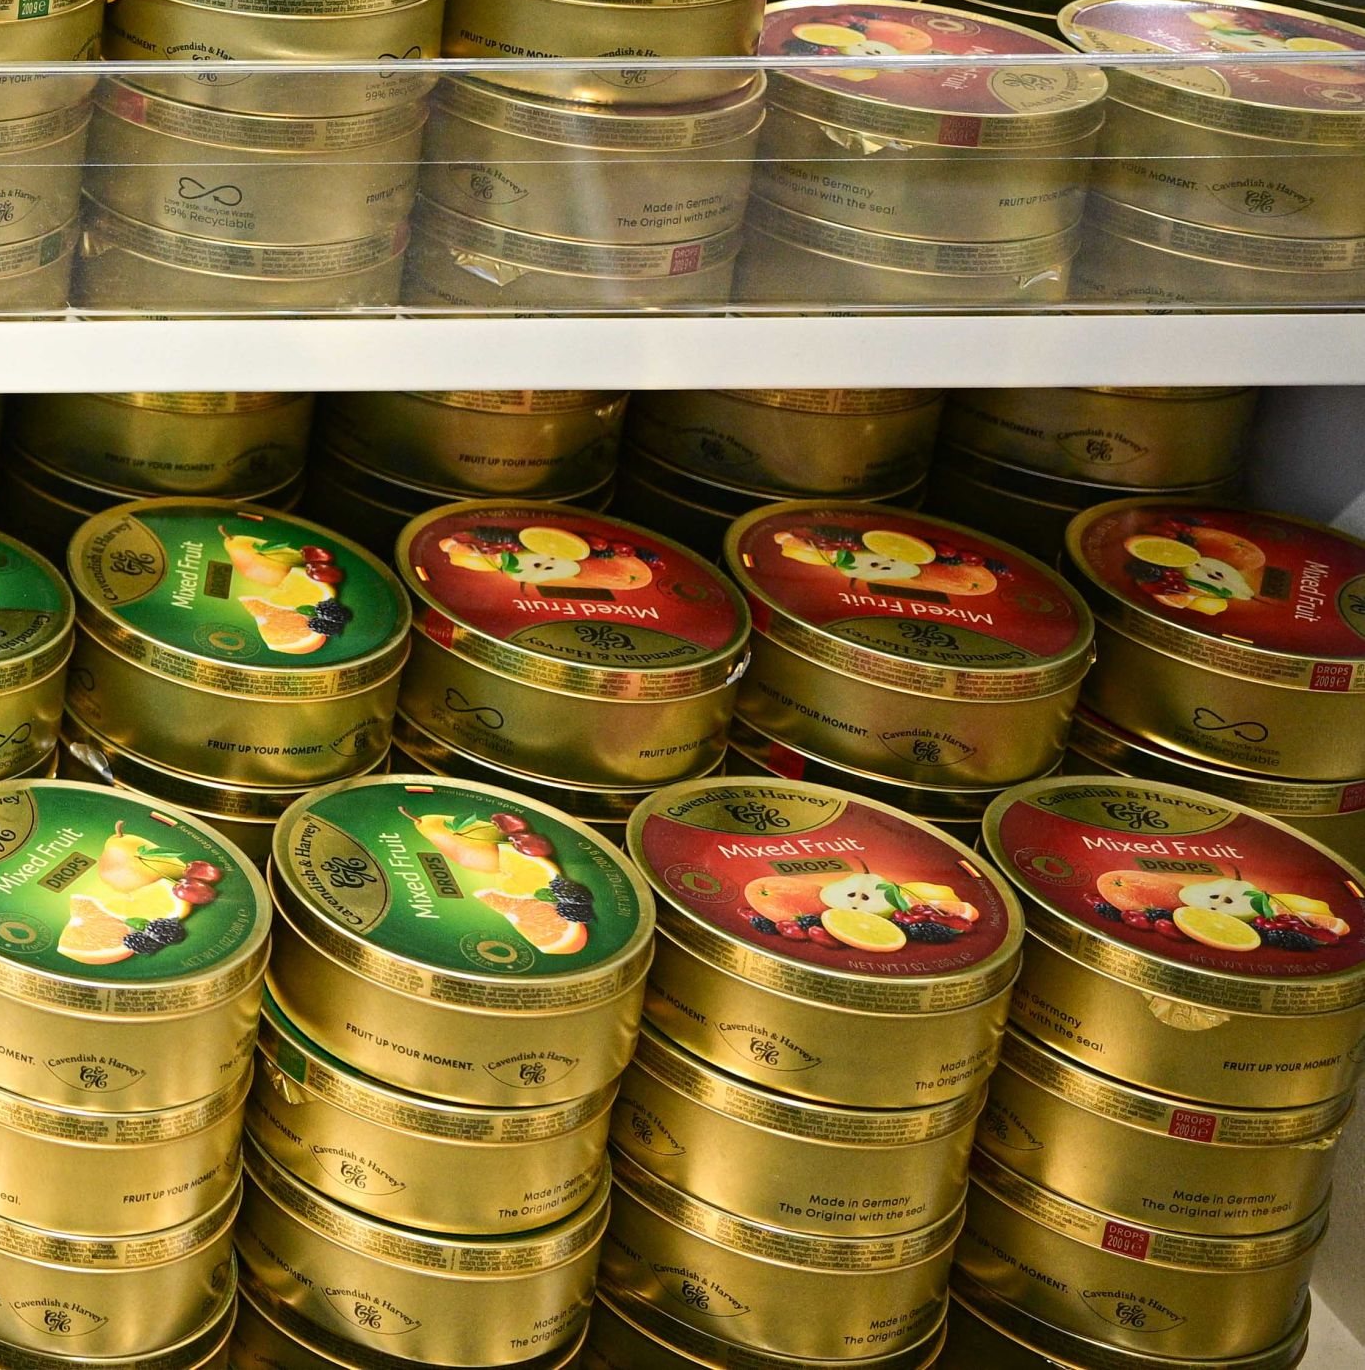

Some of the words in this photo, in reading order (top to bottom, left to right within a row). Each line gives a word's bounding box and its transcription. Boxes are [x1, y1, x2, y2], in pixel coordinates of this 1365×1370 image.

[171, 573, 193, 609] Mixed
[183, 541, 203, 574] Fruit
[513, 599, 578, 612] Fruit
[585, 604, 658, 619] Mixed
[840, 593, 906, 612] Fruit
[913, 601, 992, 625] Mixed
[667, 789, 739, 818] Cavendish
[39, 828, 83, 869] Fruit
[381, 832, 413, 871] Fruit
[718, 841, 797, 859] Mixed
[802, 836, 865, 853] Fruit
[1082, 836, 1168, 856] Mixed
[1172, 842, 1244, 859] Fruit
[51, 857, 90, 889] DROPS
[431, 855, 455, 897] DROPS
[778, 859, 842, 873] DROPS
[1142, 860, 1214, 874] DROPS
[401, 870, 439, 919] Mixed
[346, 1023, 372, 1043] FRUIT
[375, 1038, 387, 1049] UP
[390, 1042, 420, 1059] YOUR
